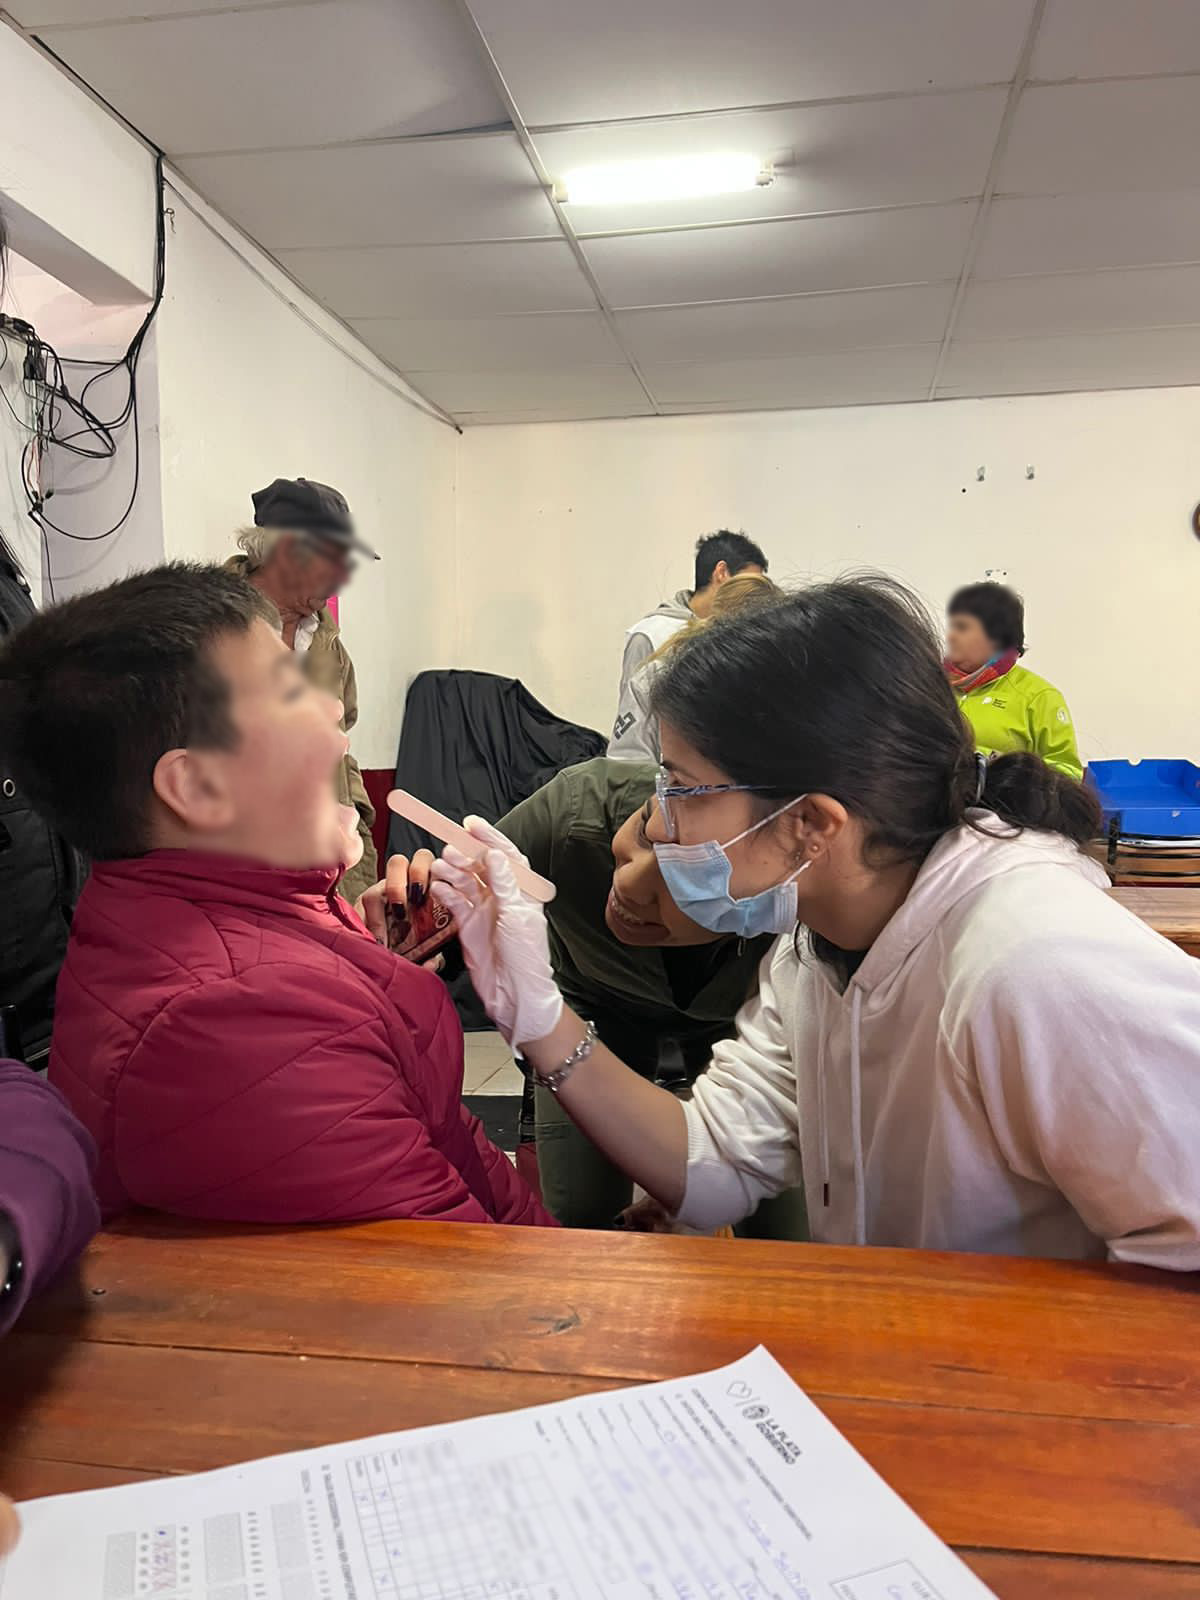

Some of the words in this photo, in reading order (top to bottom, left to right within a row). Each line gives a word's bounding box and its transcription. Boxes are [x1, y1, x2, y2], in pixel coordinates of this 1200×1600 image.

[756, 1422, 796, 1465] GOBIERNO
[765, 1418, 780, 1431] LA
[777, 1431, 802, 1458] PLATA
